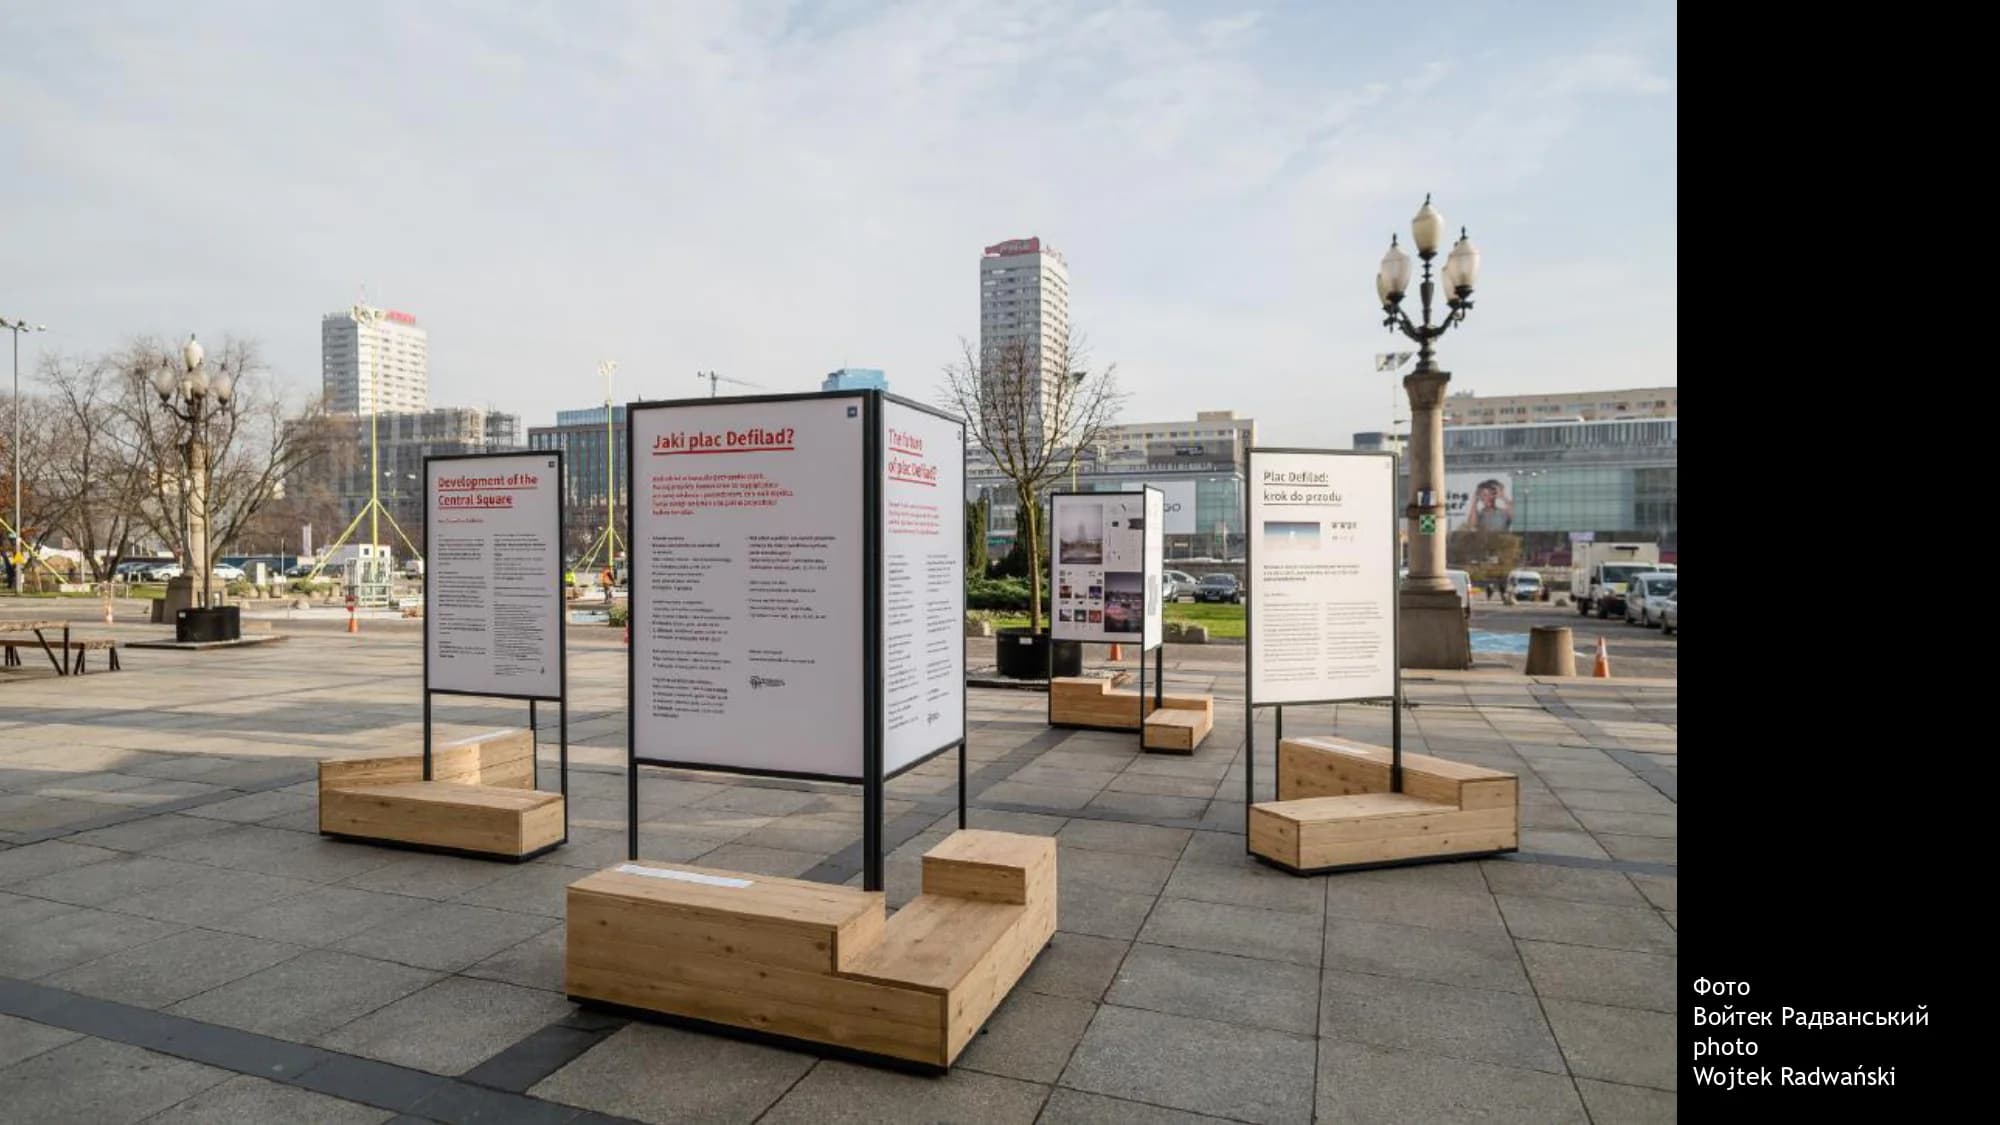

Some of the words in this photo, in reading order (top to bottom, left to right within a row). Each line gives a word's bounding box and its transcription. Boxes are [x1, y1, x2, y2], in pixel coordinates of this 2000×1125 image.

[653, 432, 685, 450] Jaki
[689, 431, 722, 451] plac
[726, 428, 795, 447] Defilad?
[438, 475, 505, 490] Development
[507, 473, 519, 486] of
[520, 473, 538, 485] the
[1263, 471, 1286, 482] Plac
[438, 494, 474, 506] Central
[476, 494, 513, 508] Square
[1263, 489, 1288, 502] krok
[1290, 490, 1304, 502] do
[1305, 491, 1342, 505] przodu
